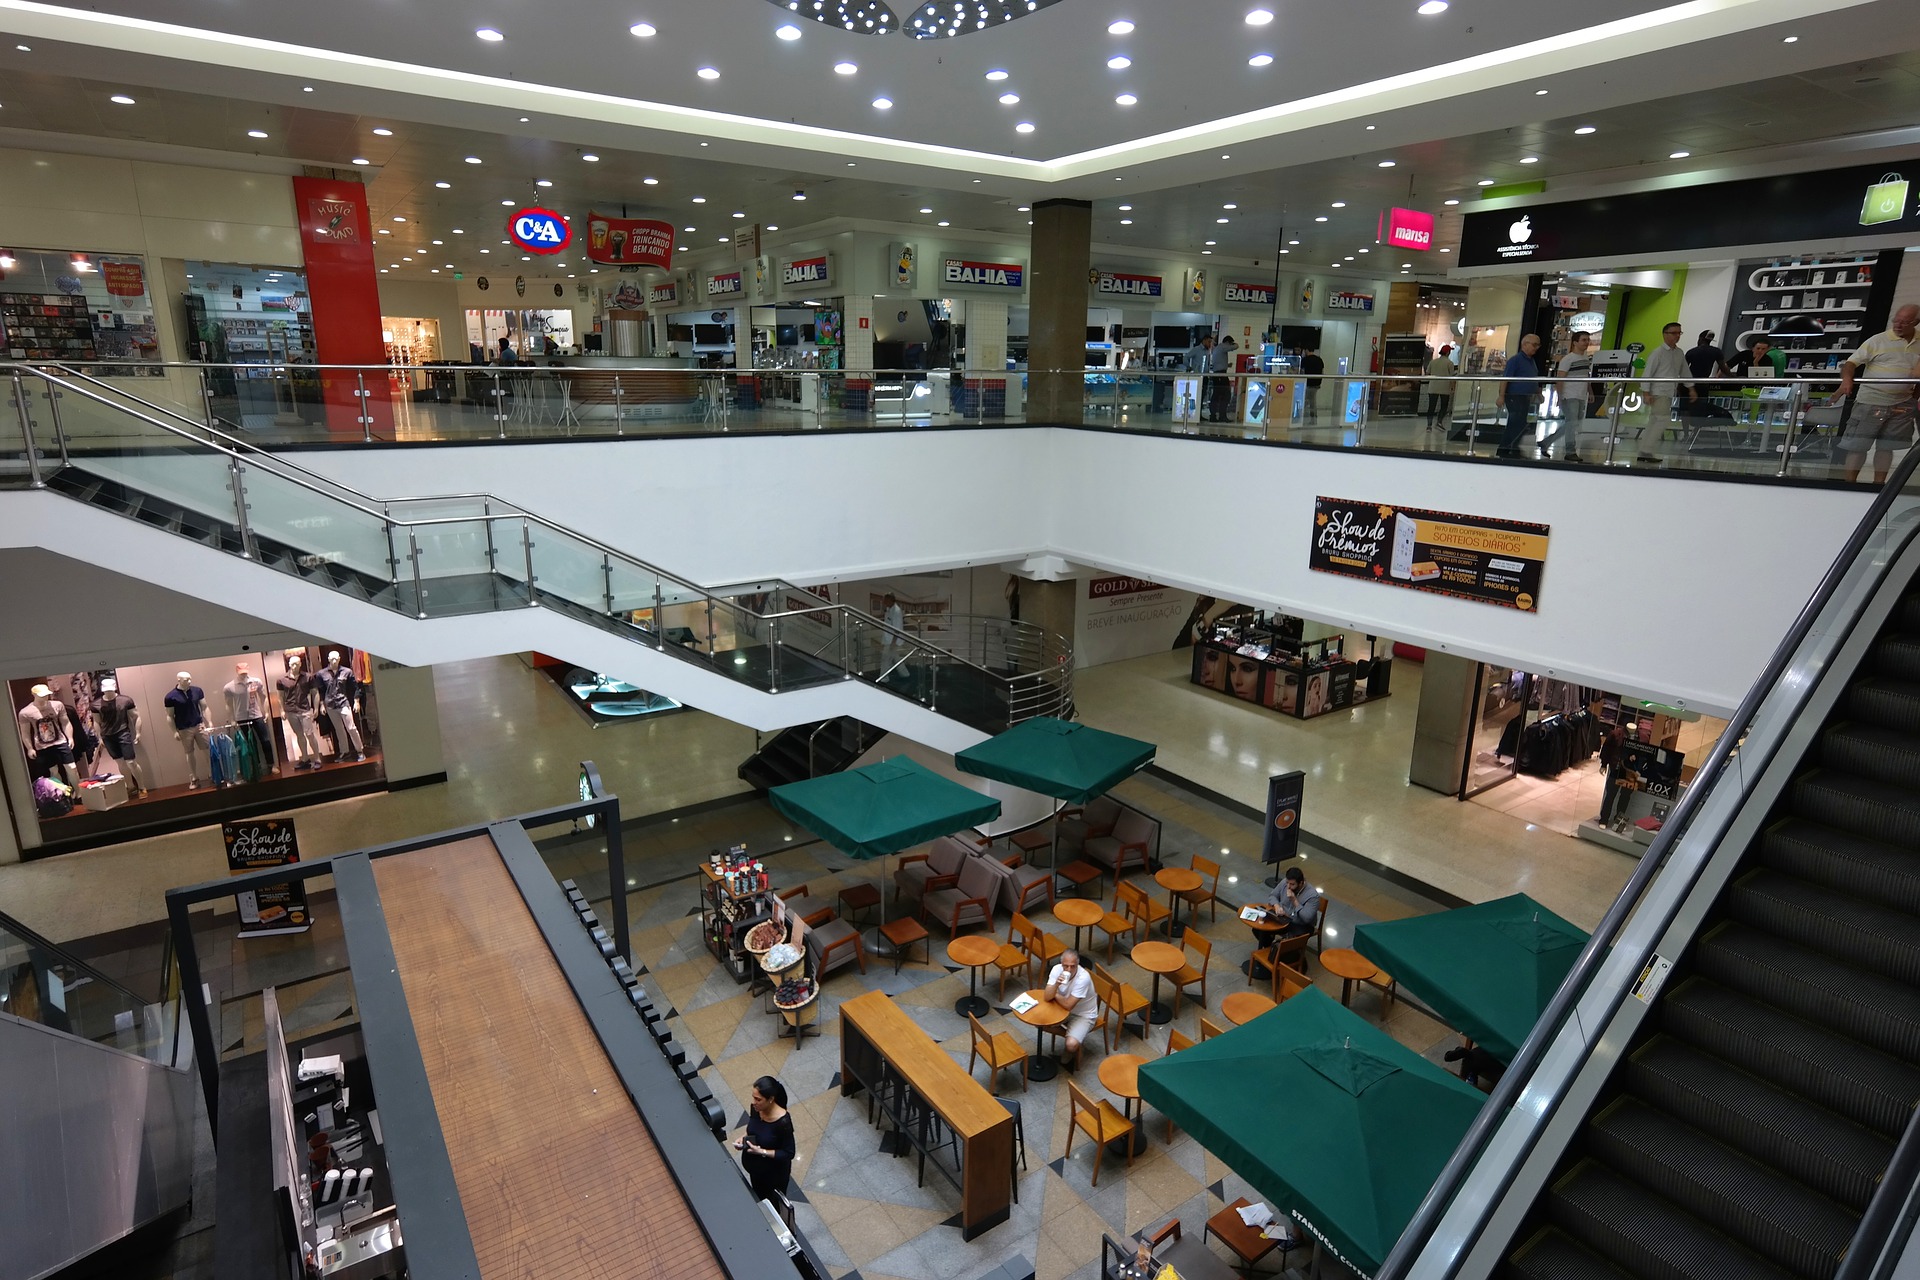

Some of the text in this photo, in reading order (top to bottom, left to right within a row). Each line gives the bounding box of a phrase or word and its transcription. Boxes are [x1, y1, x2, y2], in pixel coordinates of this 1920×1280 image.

[317, 204, 351, 216] MUSIC
[515, 218, 562, 243] C&A
[651, 229, 670, 240] BRAHMA
[1395, 227, 1429, 244] marisa
[632, 235, 670, 249] TRINCANDO
[633, 245, 665, 257] BEM AQUI.
[784, 265, 818, 283] BAHIA
[946, 266, 1008, 285] BAHIA
[708, 279, 735, 294] BAHIA
[1100, 279, 1150, 294] BAHIA
[650, 289, 670, 303] BAHIA
[1226, 288, 1267, 303] BAHIA
[1329, 296, 1364, 309] BAHIA
[1327, 510, 1385, 540] Show de
[1459, 528, 1487, 537] COMPRAS
[1318, 527, 1379, 556] Prêmios
[1433, 532, 1520, 553] SORTEIOS DIÁRIOS
[1342, 552, 1372, 562] SHOPPING
[1094, 580, 1128, 593] GOLD
[1484, 581, 1519, 593] IPHONES 6S
[1110, 592, 1163, 607] Sempre Presente
[810, 611, 830, 624] ILVER
[1087, 605, 1182, 630] BREVE INAUGURAÇÃO
[1647, 782, 1672, 796] 10X
[237, 828, 292, 845] Show de
[232, 842, 290, 858] Prêmios
[1292, 1209, 1339, 1256] STARBUCKS
